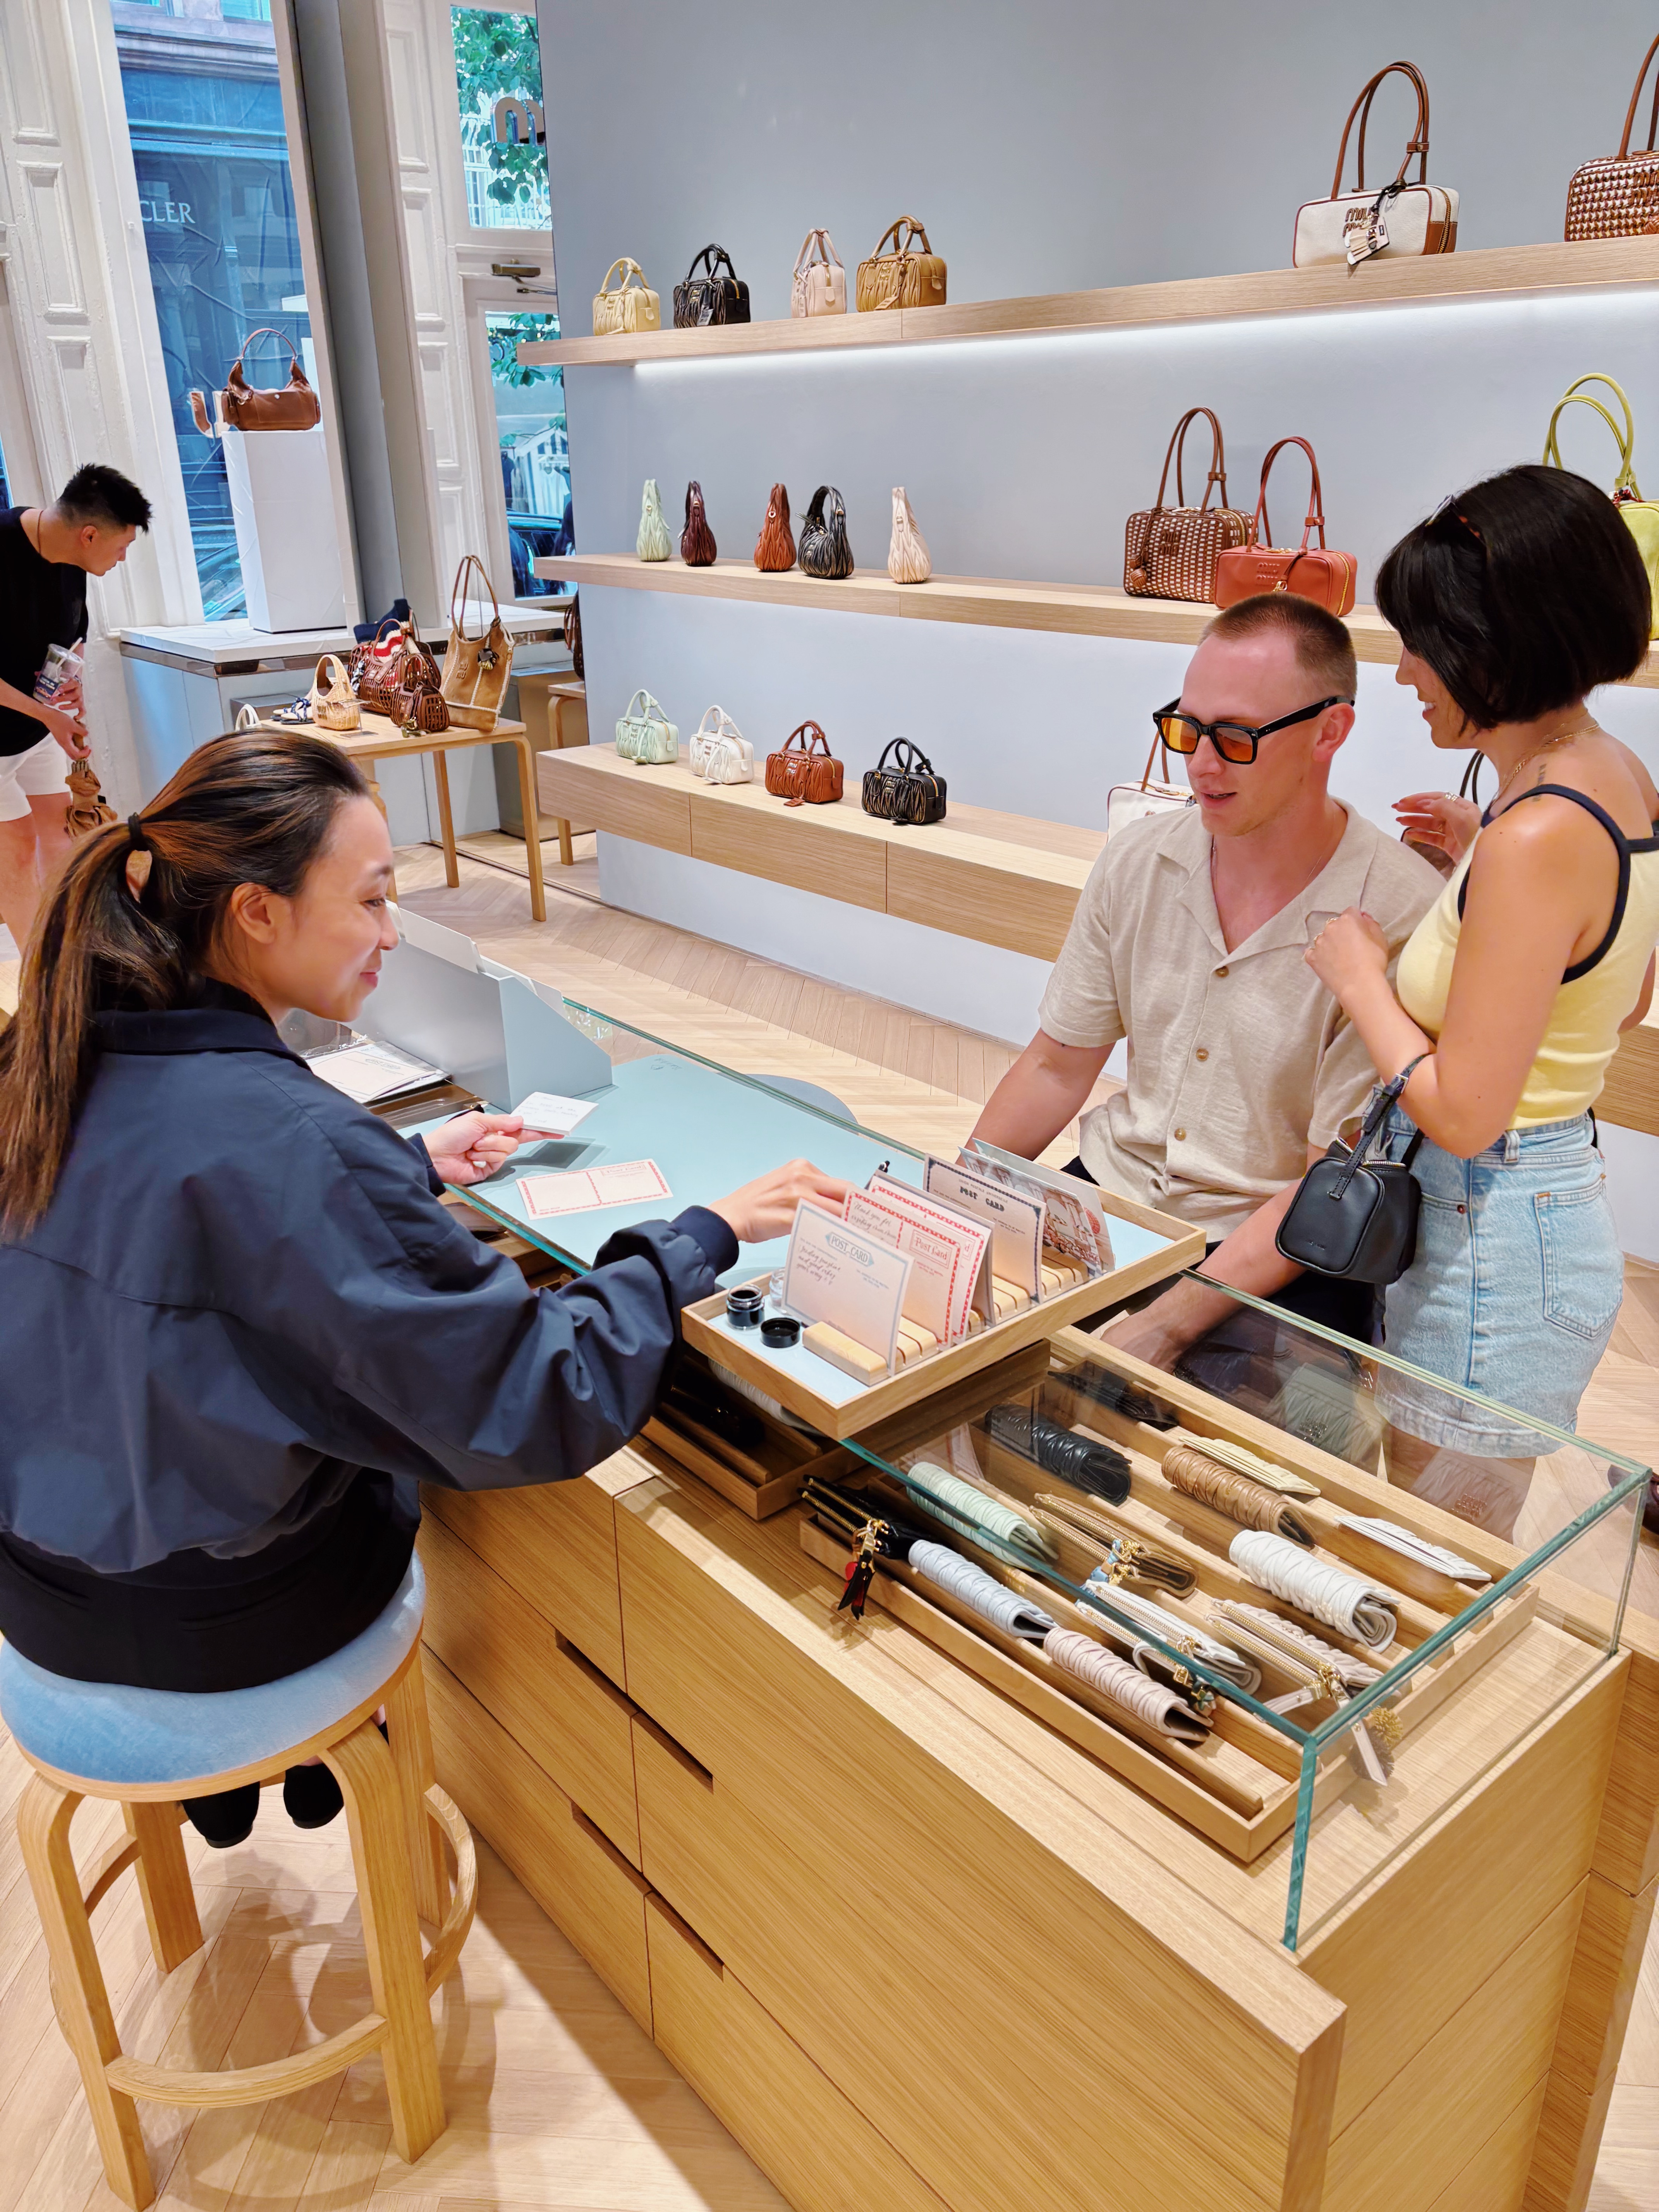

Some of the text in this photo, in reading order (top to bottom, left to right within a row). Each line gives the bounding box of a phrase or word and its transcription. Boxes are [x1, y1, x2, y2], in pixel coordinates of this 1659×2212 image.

[960, 1186, 978, 1200] POST
[985, 1198, 1005, 1212] CARD
[831, 1236, 849, 1252] POST
[850, 1247, 869, 1263] CARD
[914, 1236, 931, 1252] Post
[931, 1245, 948, 1260] Card
